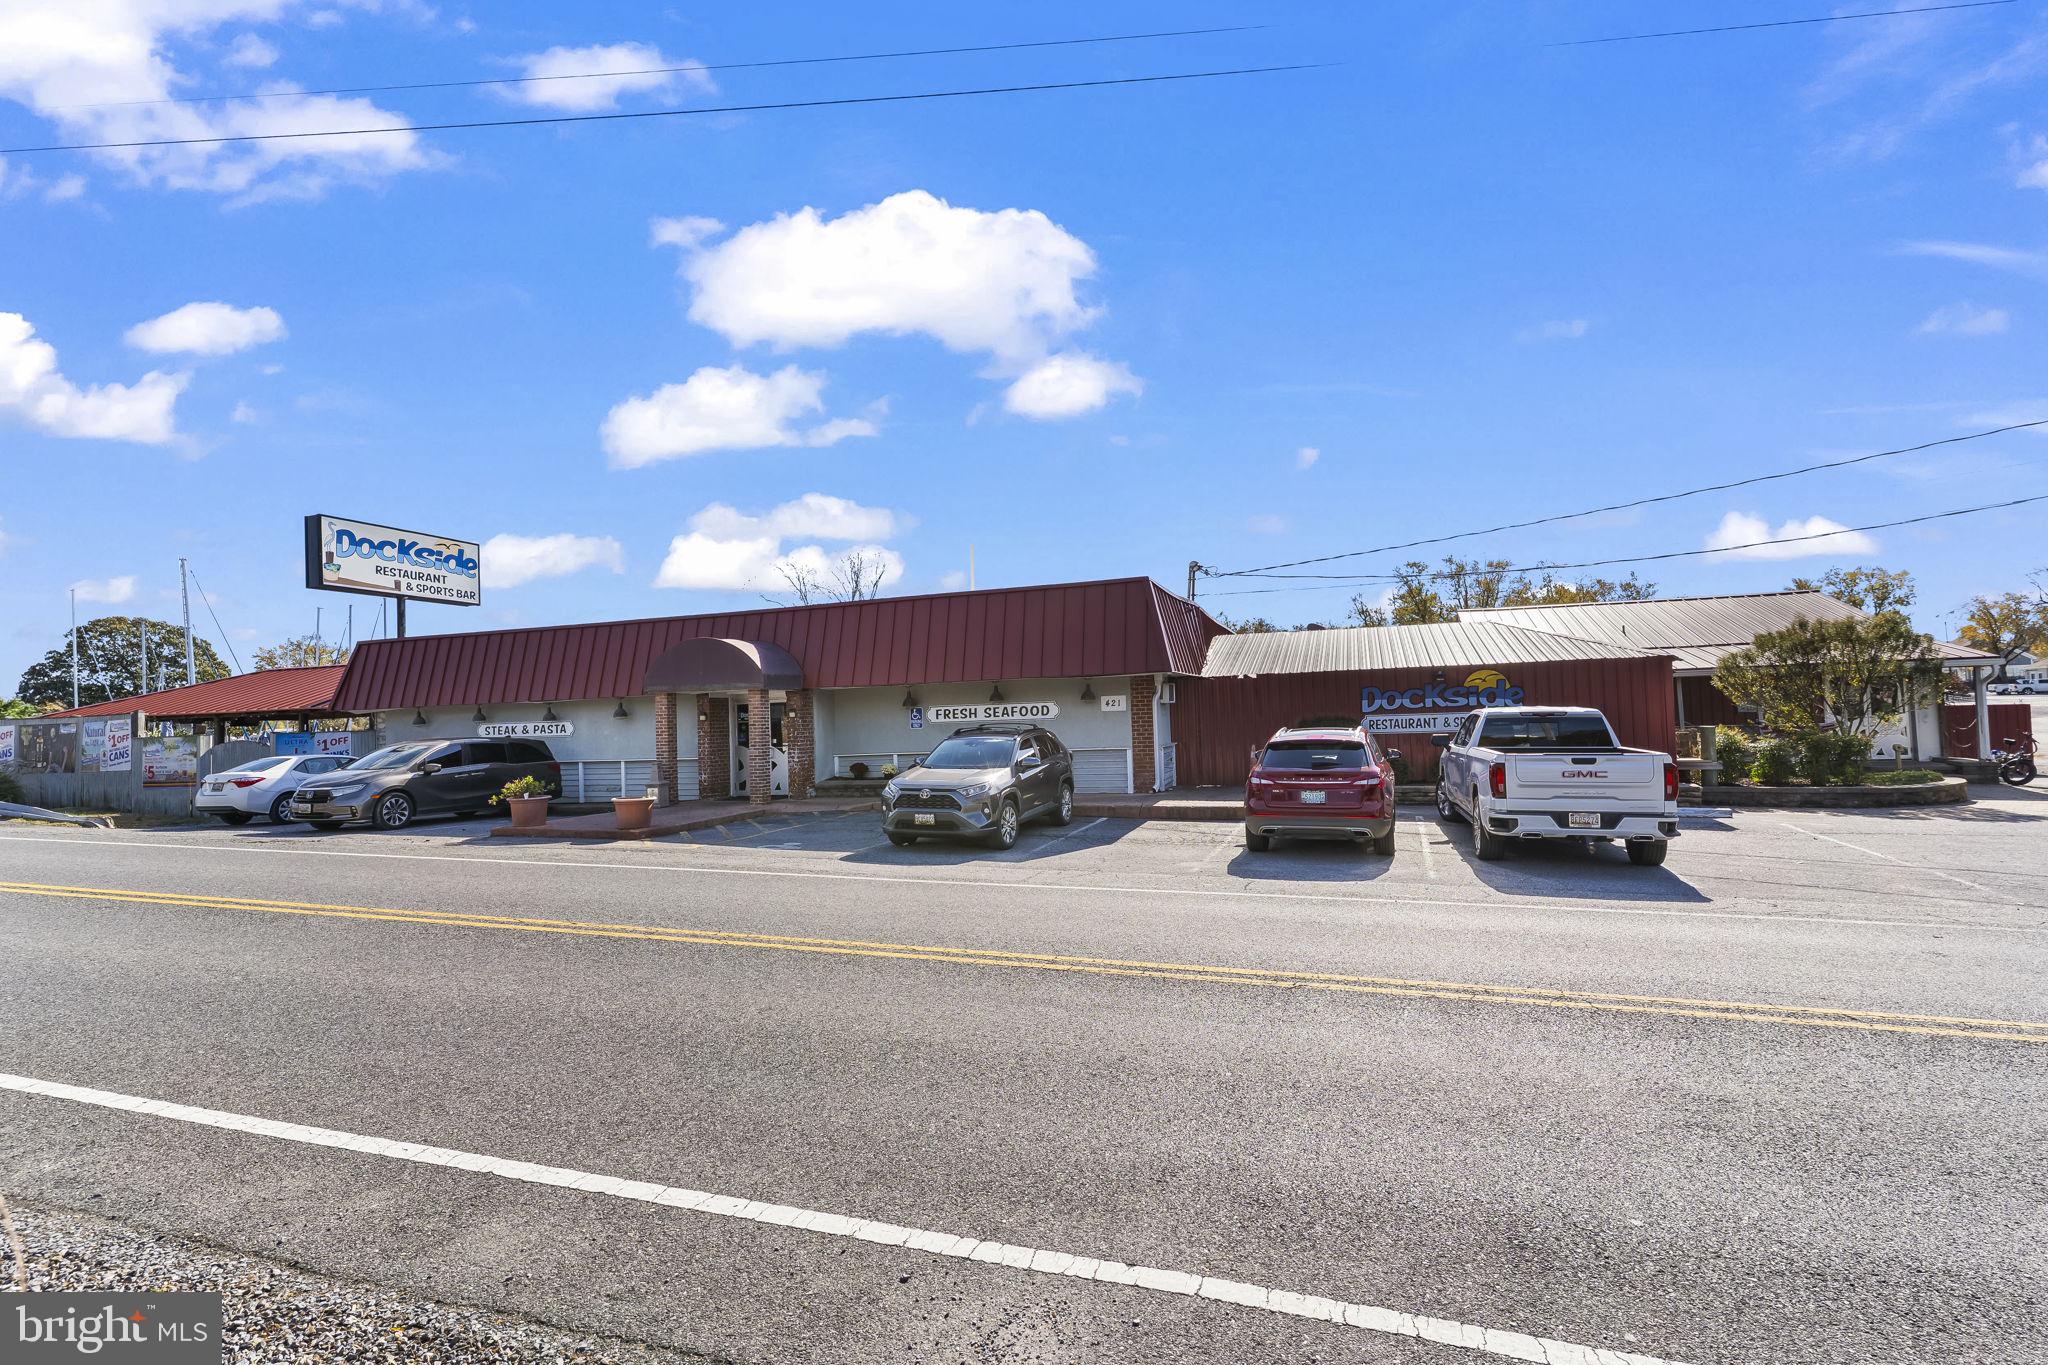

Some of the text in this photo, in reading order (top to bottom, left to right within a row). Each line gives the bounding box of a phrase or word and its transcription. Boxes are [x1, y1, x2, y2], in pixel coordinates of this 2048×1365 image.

[375, 565, 448, 584] RESTAURANT
[405, 582, 476, 600] & SPORTS BAR
[1105, 699, 1121, 708] 421
[935, 705, 1050, 720] FRESH SEAFOOD
[484, 723, 567, 736] STEAK & PASTA
[1368, 717, 1439, 730] RESTAURANT
[1443, 717, 1451, 728] &
[0, 731, 14, 740] OFF
[107, 734, 117, 748] $1
[116, 733, 130, 744] OFF
[316, 736, 349, 751] $1 OFF
[109, 749, 129, 761] CANS
[1562, 770, 1609, 778] GMC
